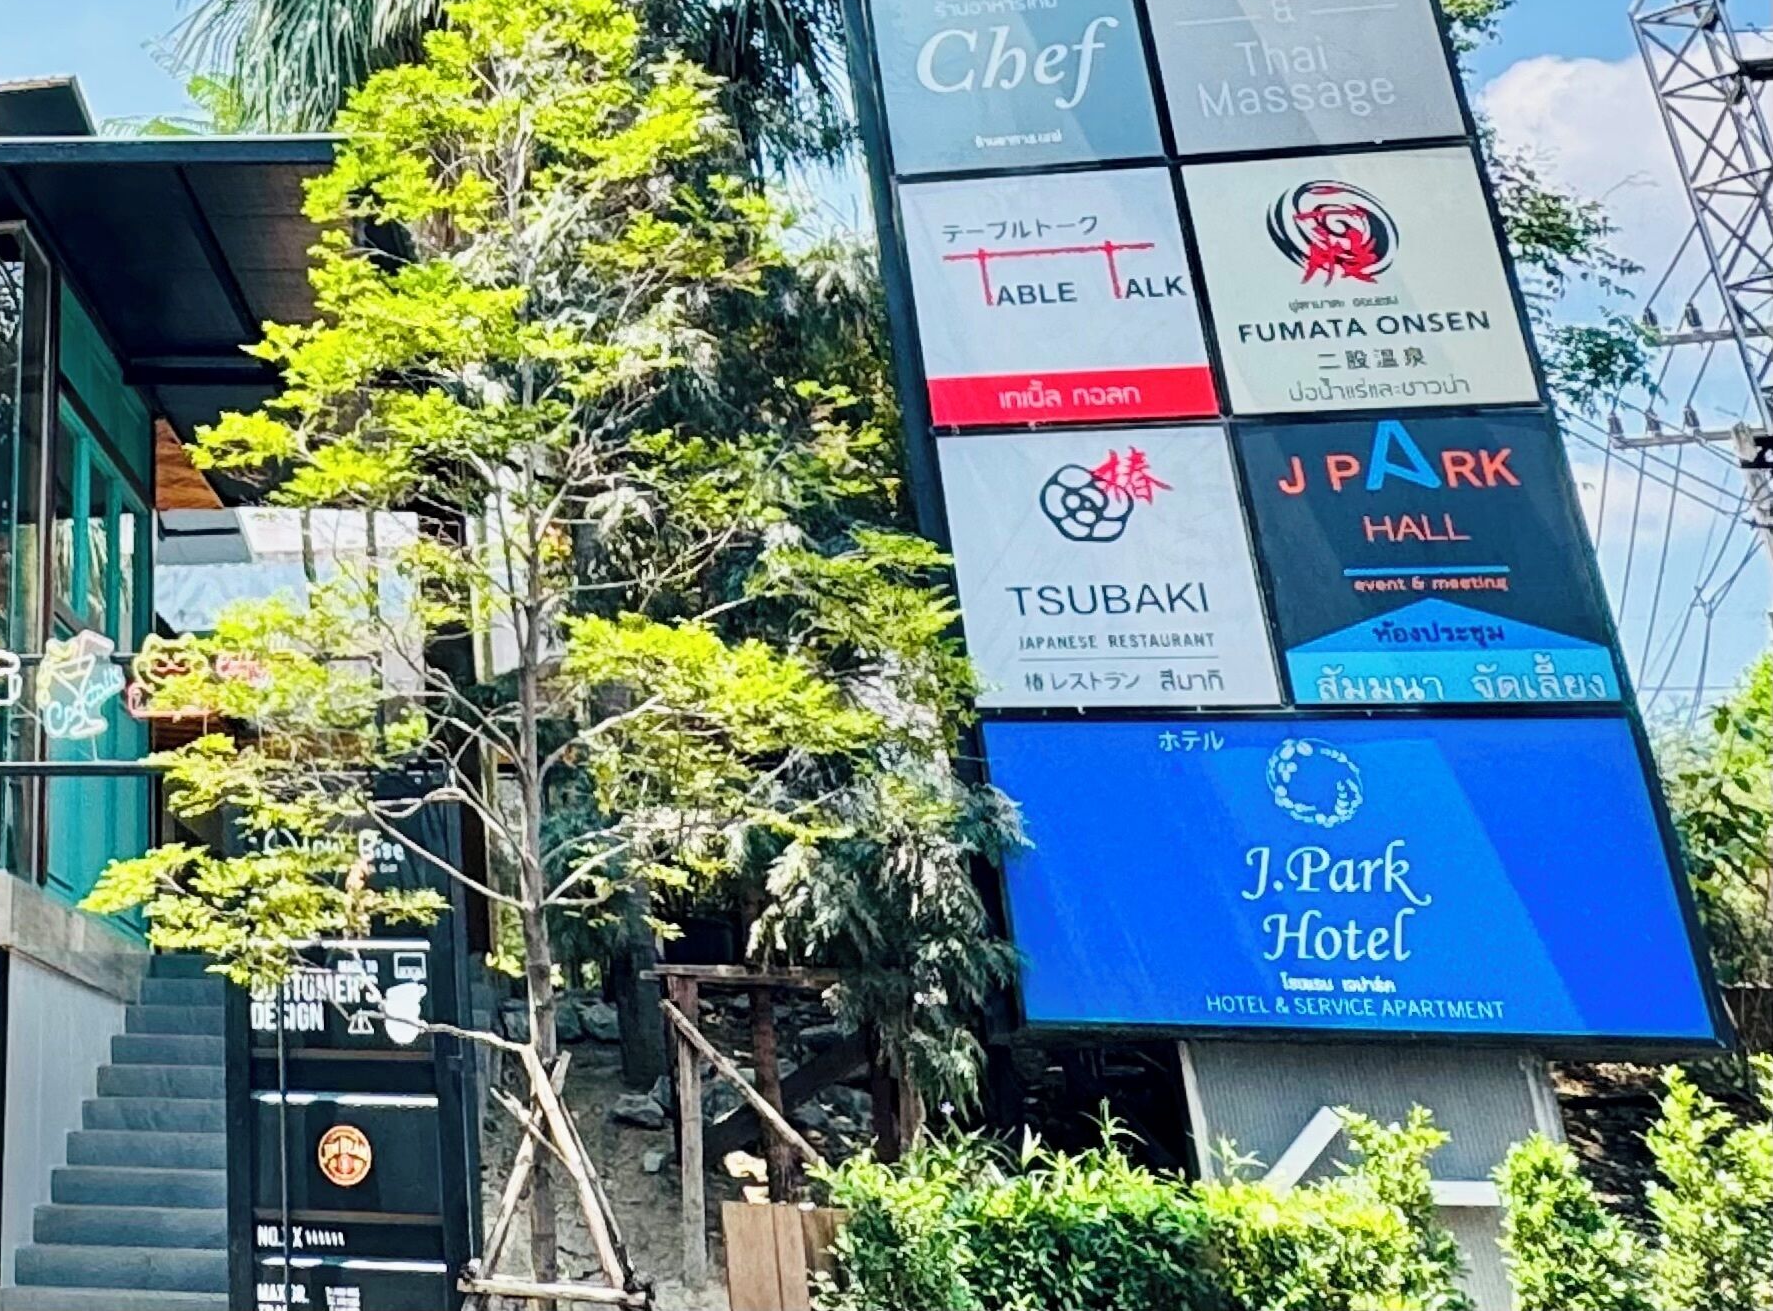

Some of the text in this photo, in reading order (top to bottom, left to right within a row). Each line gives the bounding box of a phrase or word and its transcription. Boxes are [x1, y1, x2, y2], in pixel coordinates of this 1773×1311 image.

[916, 16, 1120, 110] Chef
[1234, 35, 1329, 77] Thai
[1198, 77, 1396, 118] Massage
[943, 240, 1188, 307] TABLE TALK
[1238, 309, 1491, 344] FUMATA ONSEN
[1279, 419, 1522, 495] J PARK
[1362, 512, 1473, 542] HALL
[1005, 582, 1210, 616] TSUBAKI
[1353, 575, 1510, 592] event & meeting
[1018, 632, 1215, 651] JAPANESE RESTAURANT
[1315, 651, 1608, 702] สัมมนา จัดเลี้ยง
[1158, 730, 1225, 752] ホテル
[1241, 839, 1433, 907] J.Park
[1262, 907, 1417, 962] Hotel
[1205, 994, 1505, 1020] HOTEL & SERVICE APARTMENT
